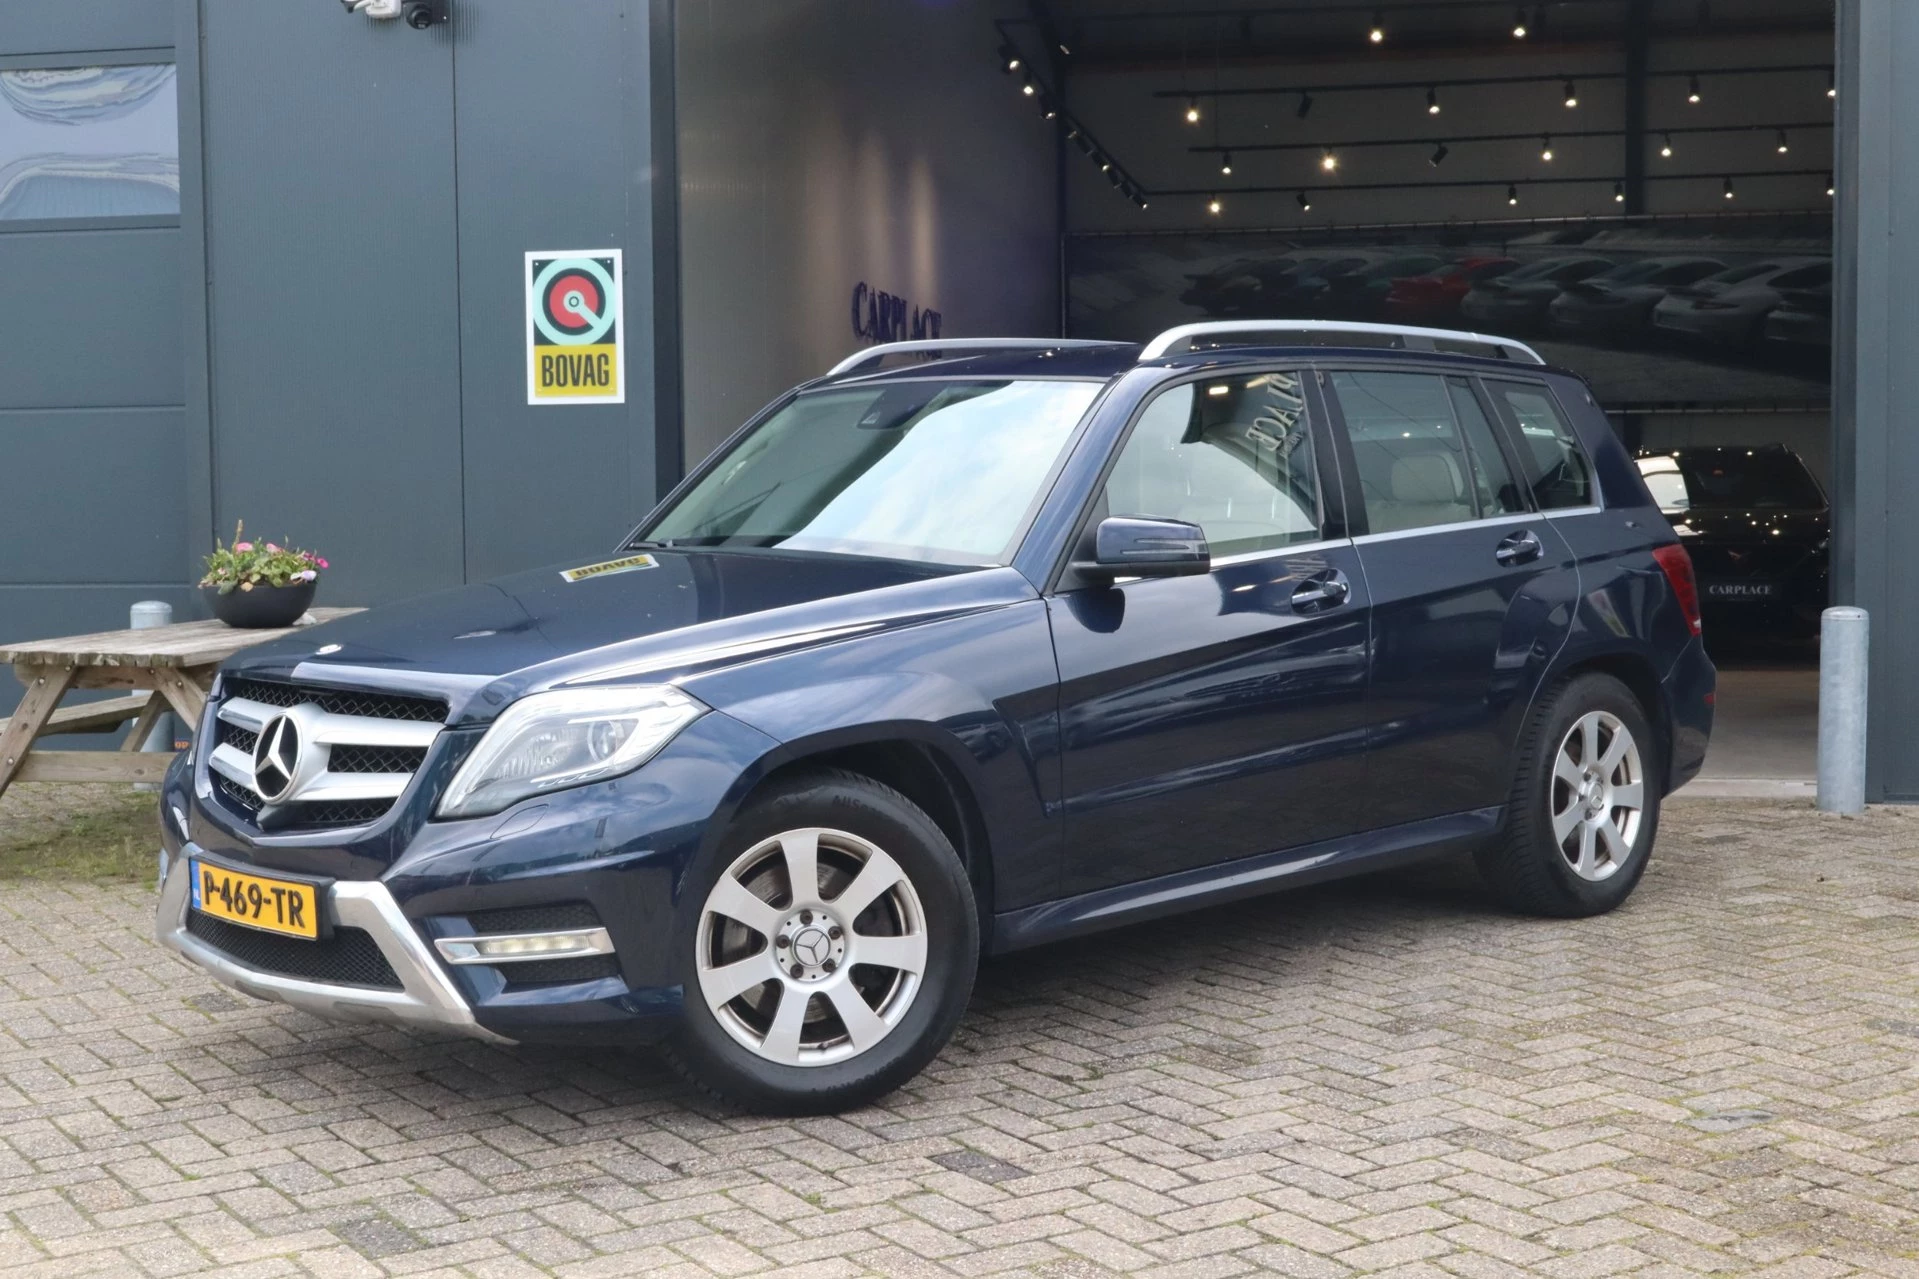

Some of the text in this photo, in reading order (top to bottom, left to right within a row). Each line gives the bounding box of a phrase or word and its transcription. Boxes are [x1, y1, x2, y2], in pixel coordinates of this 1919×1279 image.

[541, 353, 610, 387] BOVAG
[1709, 584, 1772, 595] CARPLACE
[203, 870, 305, 928] P-469-TR
